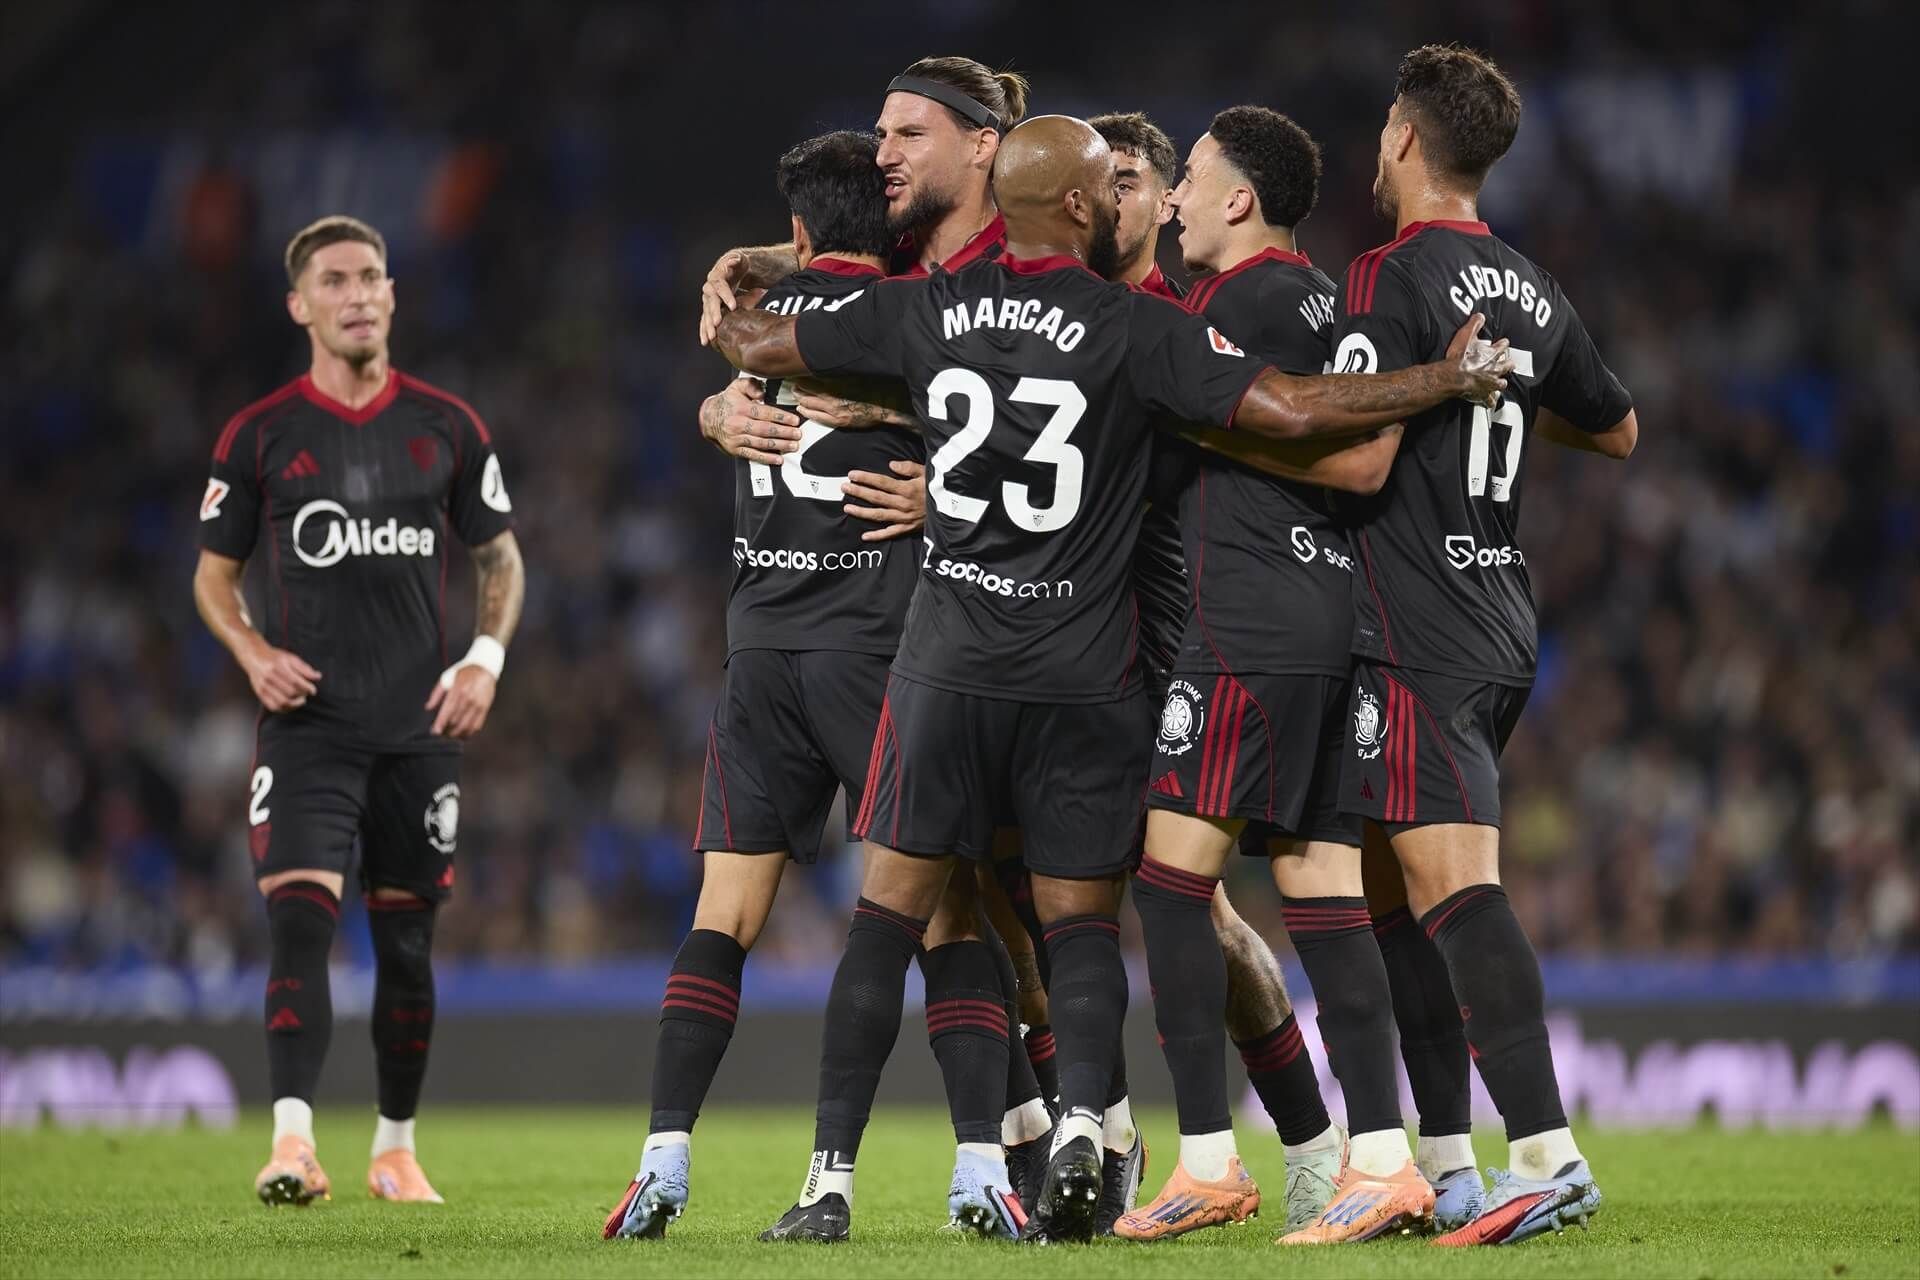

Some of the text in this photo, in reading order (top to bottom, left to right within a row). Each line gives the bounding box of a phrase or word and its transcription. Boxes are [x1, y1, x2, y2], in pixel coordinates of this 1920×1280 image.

[943, 297, 1086, 353] MARCAO
[927, 367, 1088, 532] 23
[293, 499, 435, 568] Midea
[1182, 681, 1203, 703] TIME
[250, 765, 273, 826] 2
[806, 1151, 824, 1199] DESIGN
